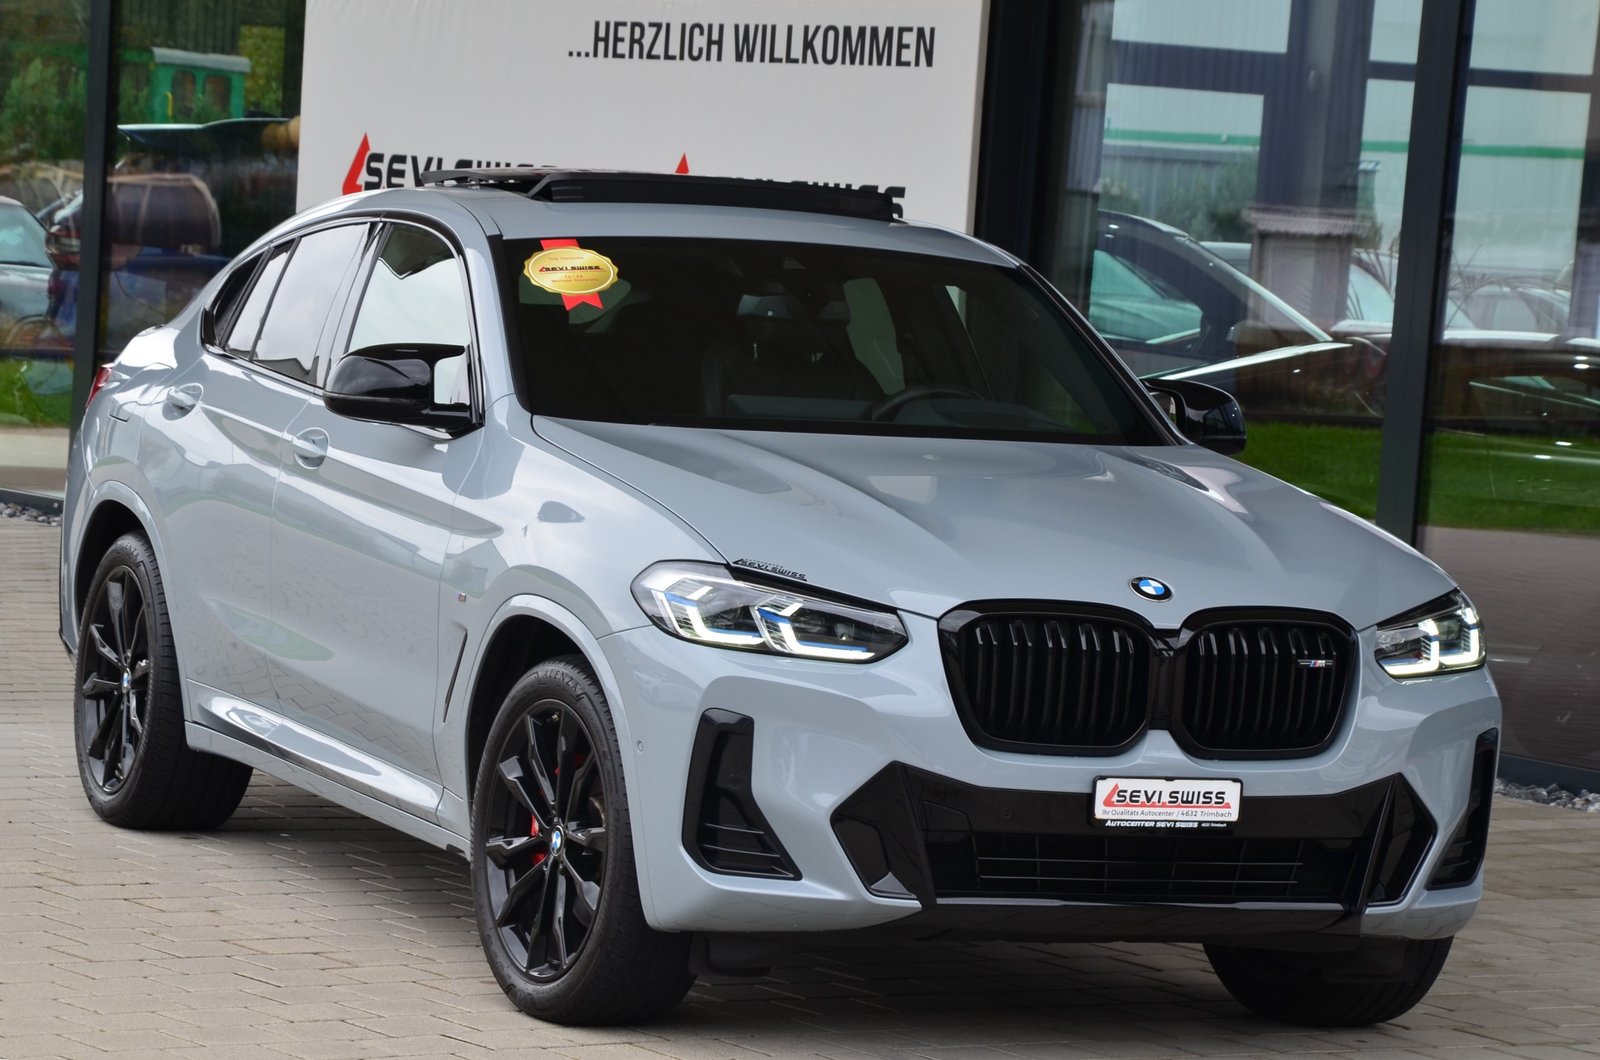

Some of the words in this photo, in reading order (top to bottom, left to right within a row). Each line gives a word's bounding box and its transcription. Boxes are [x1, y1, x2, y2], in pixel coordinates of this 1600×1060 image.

[734, 23, 936, 68] WILLKOMMEN
[1115, 789, 1162, 804] SEVI
[1169, 790, 1226, 805] SWISS
